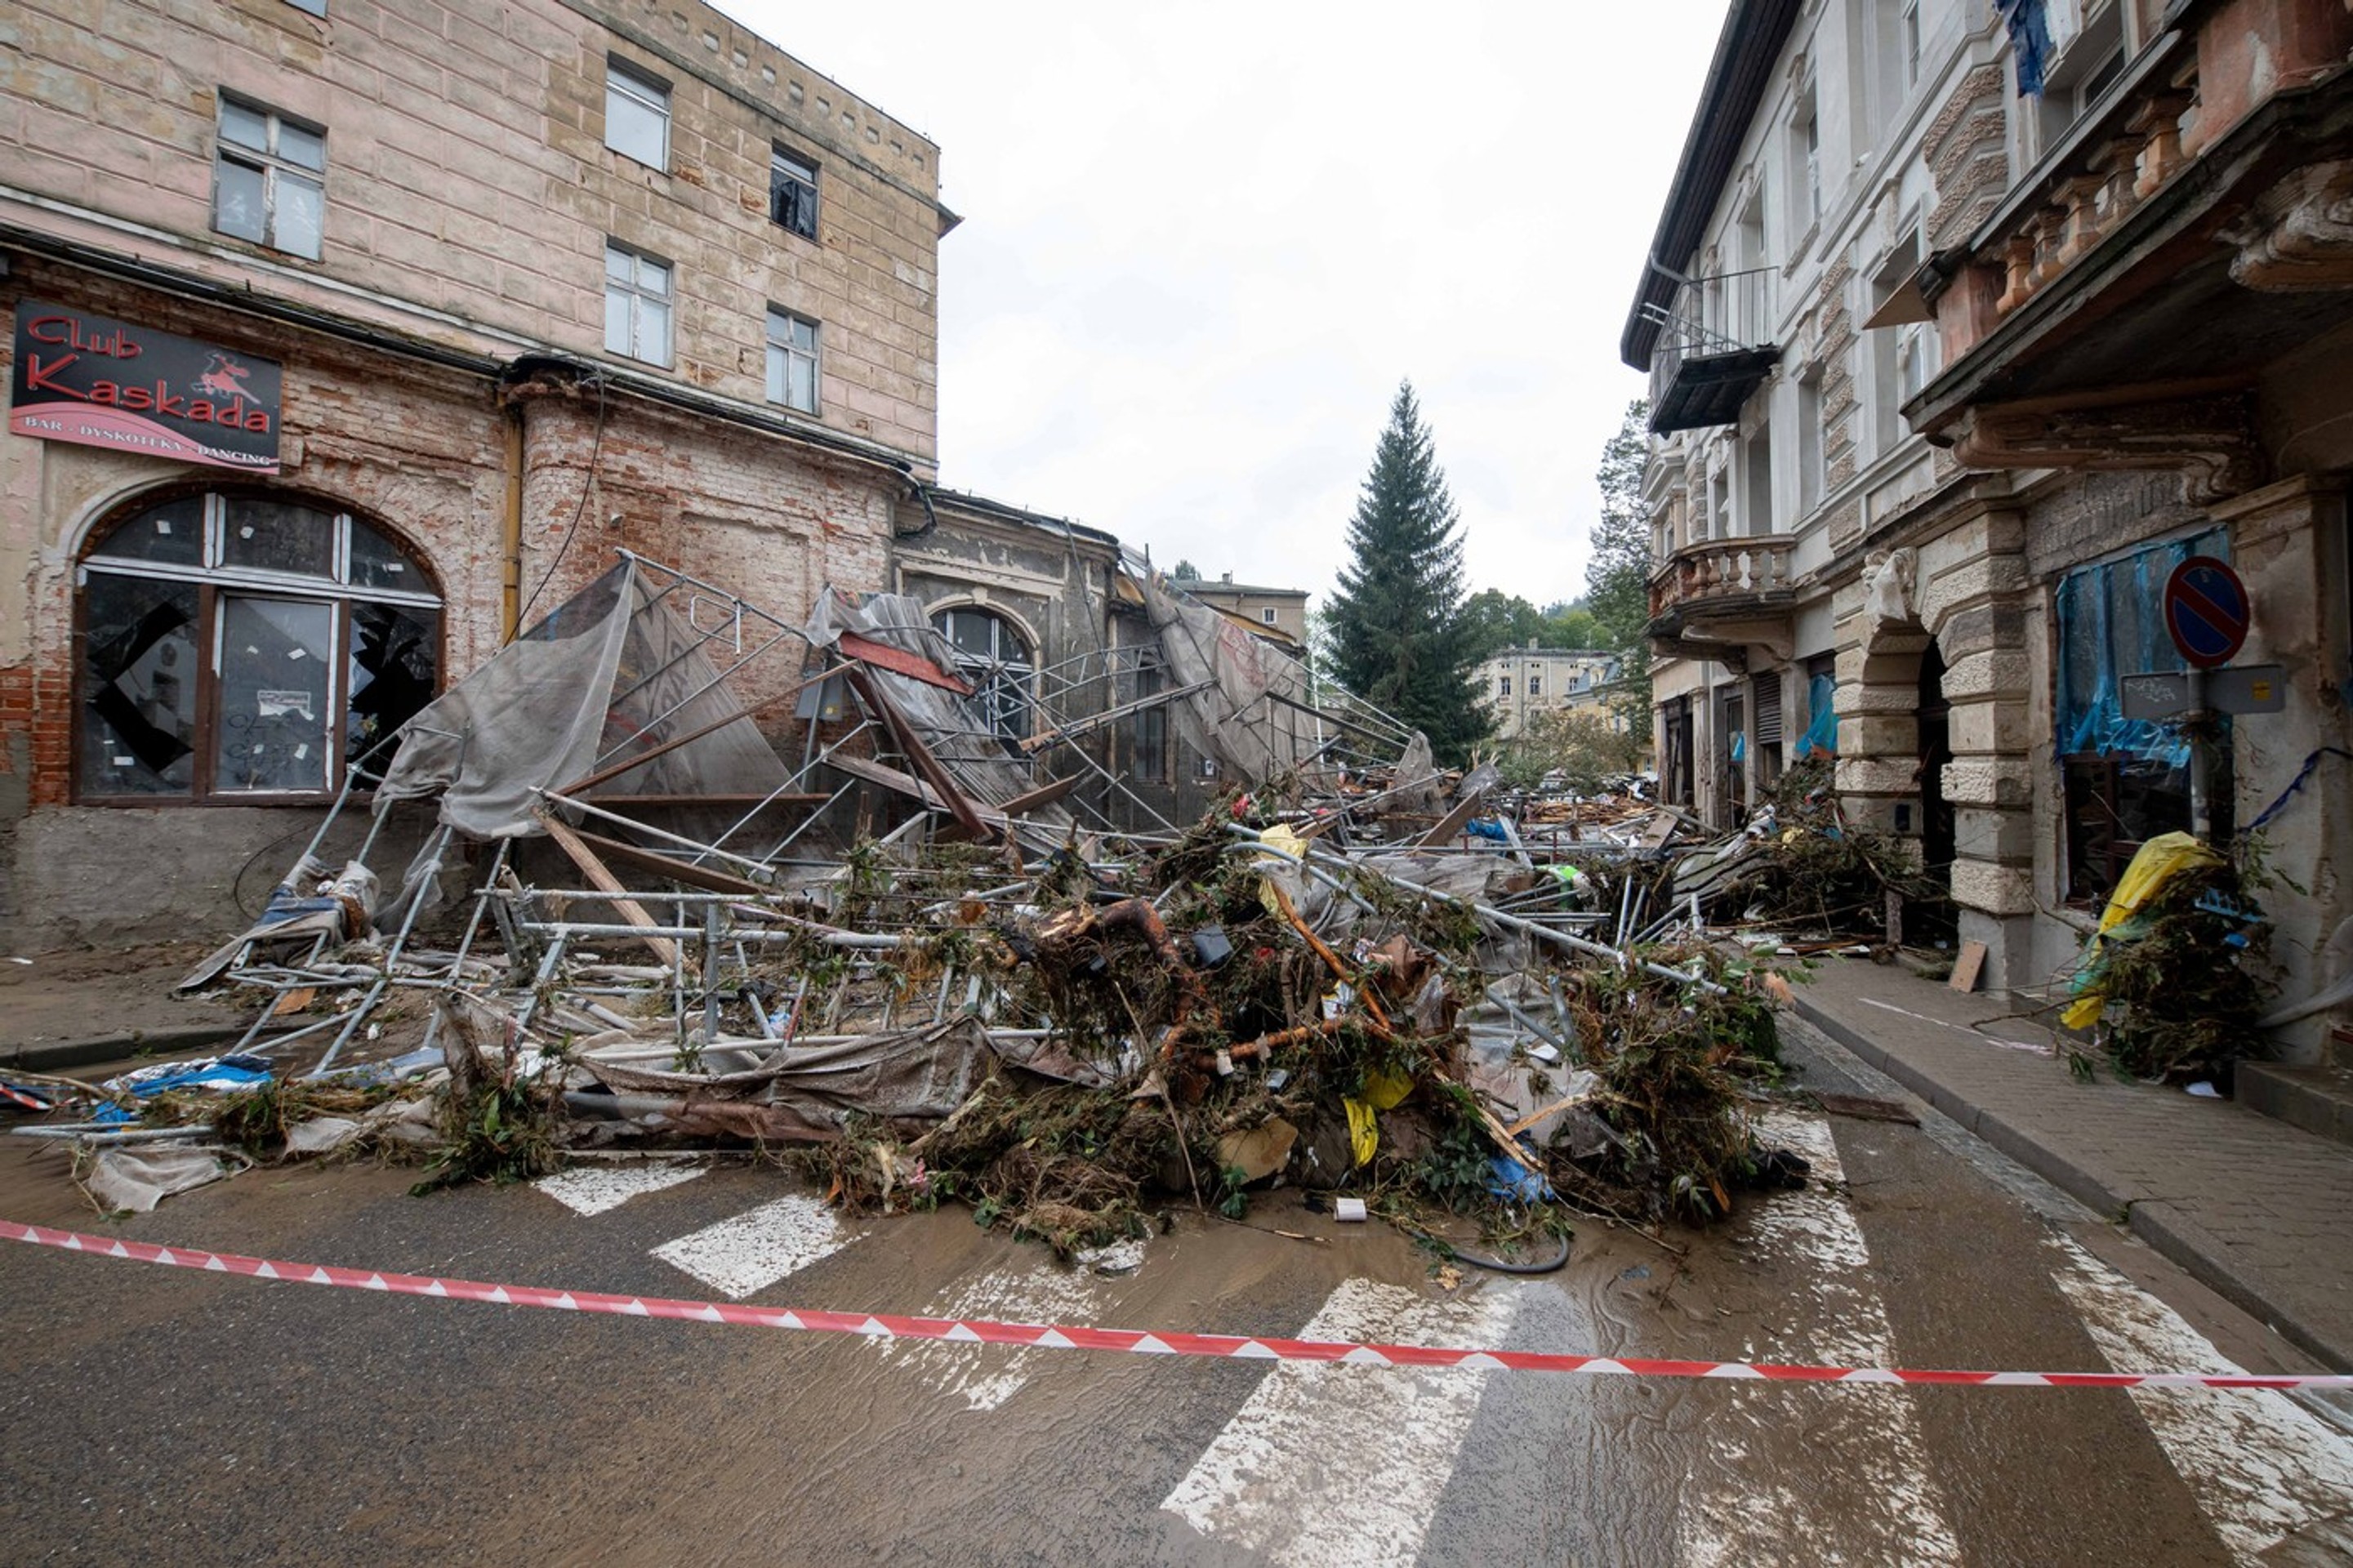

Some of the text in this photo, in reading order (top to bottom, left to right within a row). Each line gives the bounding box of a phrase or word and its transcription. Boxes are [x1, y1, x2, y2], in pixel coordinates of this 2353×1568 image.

[27, 315, 143, 359] Club
[27, 353, 270, 433] Kaskada
[25, 416, 62, 432] BAR
[79, 425, 181, 451] DYSKOTEKA
[198, 444, 270, 466] DANCING
